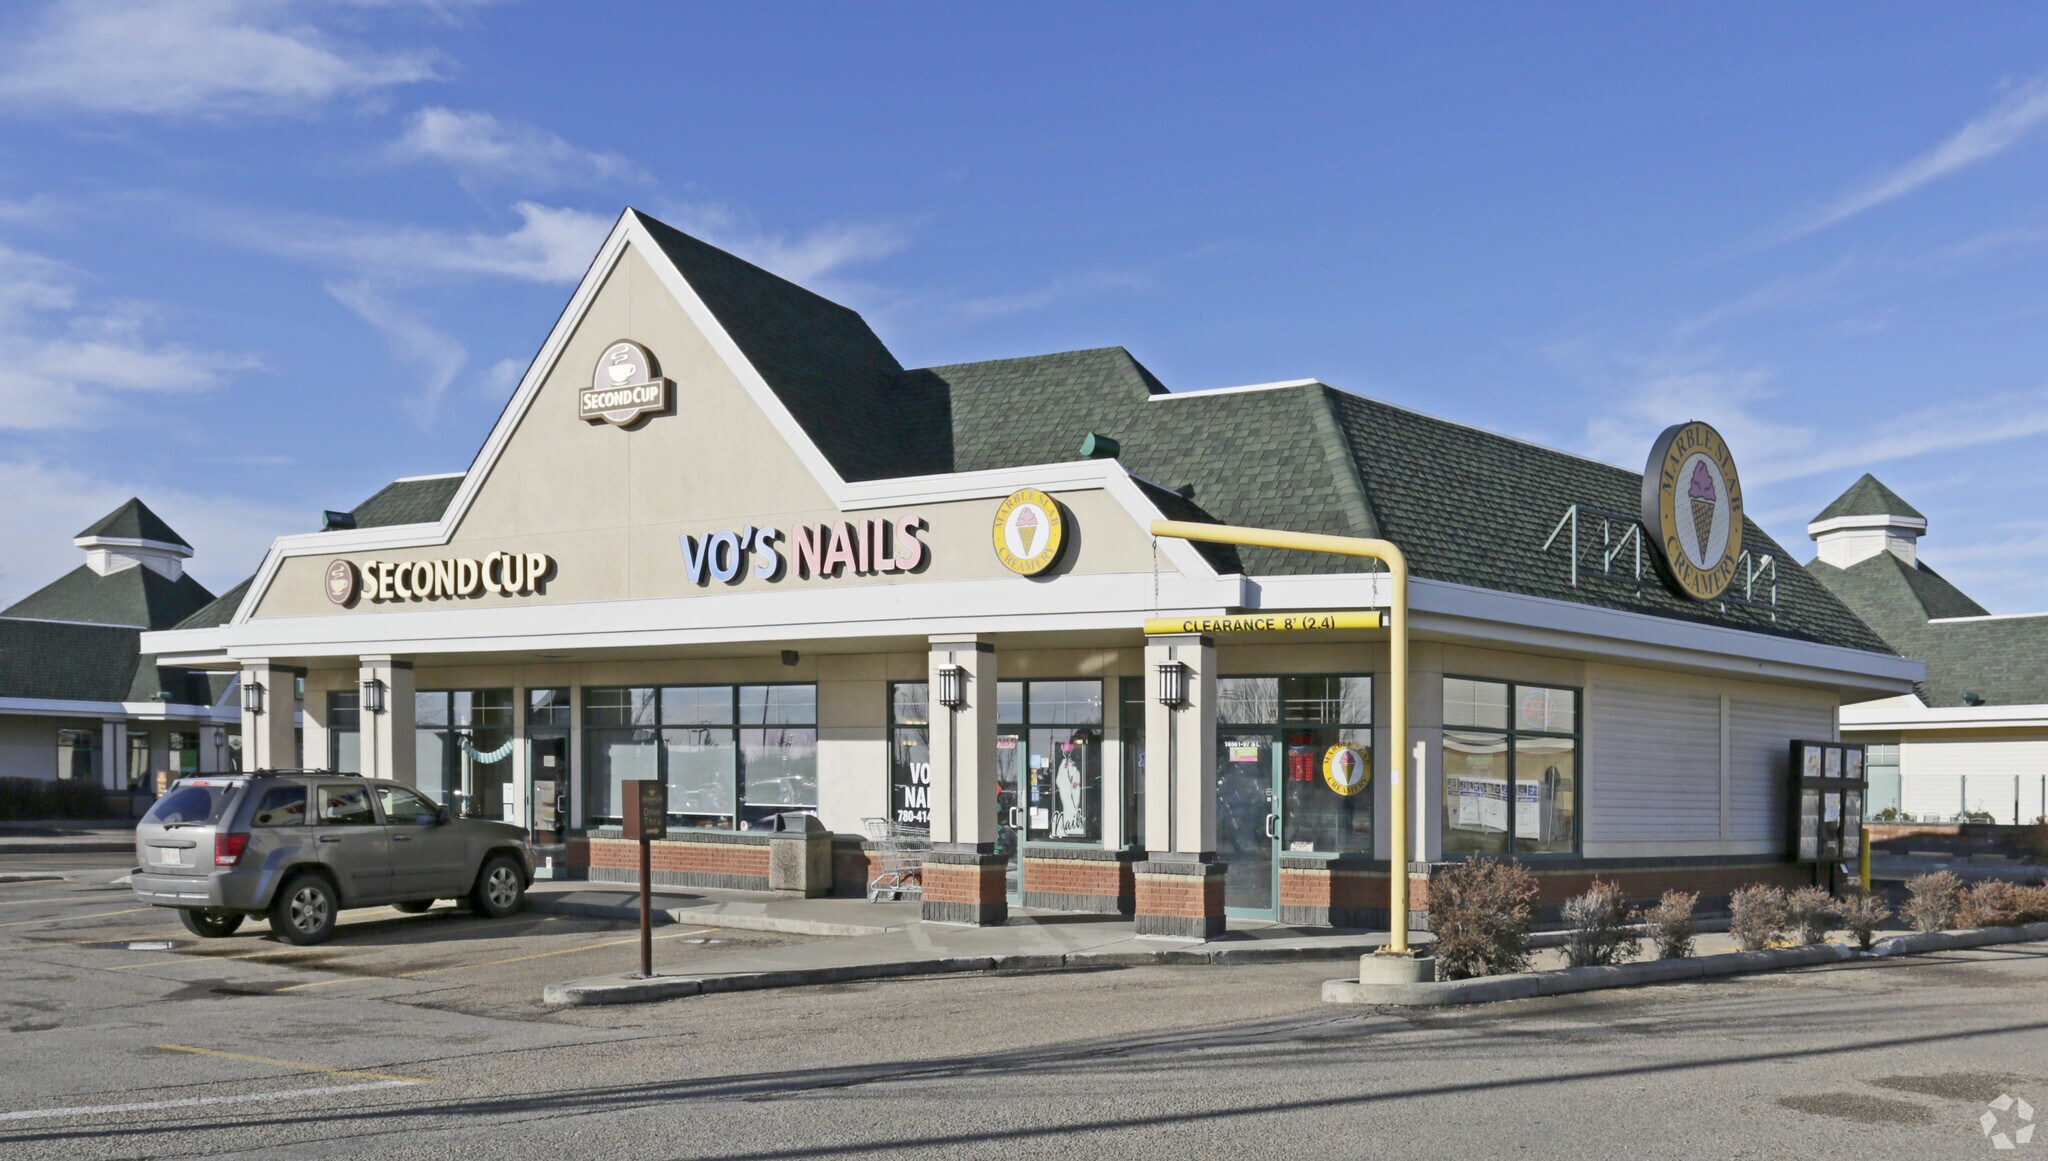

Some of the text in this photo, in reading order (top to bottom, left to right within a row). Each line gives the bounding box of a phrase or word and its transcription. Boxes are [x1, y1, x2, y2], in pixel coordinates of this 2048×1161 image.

[1662, 426, 1741, 512] MARBLE SLAB
[995, 491, 1060, 527] MARBLE SLAB
[679, 514, 922, 583] VO'S NAILS
[998, 547, 1055, 571] CREAMERY
[1667, 535, 1736, 595] CREAMERY
[360, 551, 548, 600] SECOND CUP
[1183, 615, 1336, 633] CLEARANCE 8' (2.4)
[1327, 777, 1367, 794] CREAMERY
[1051, 808, 1084, 837] Nails
